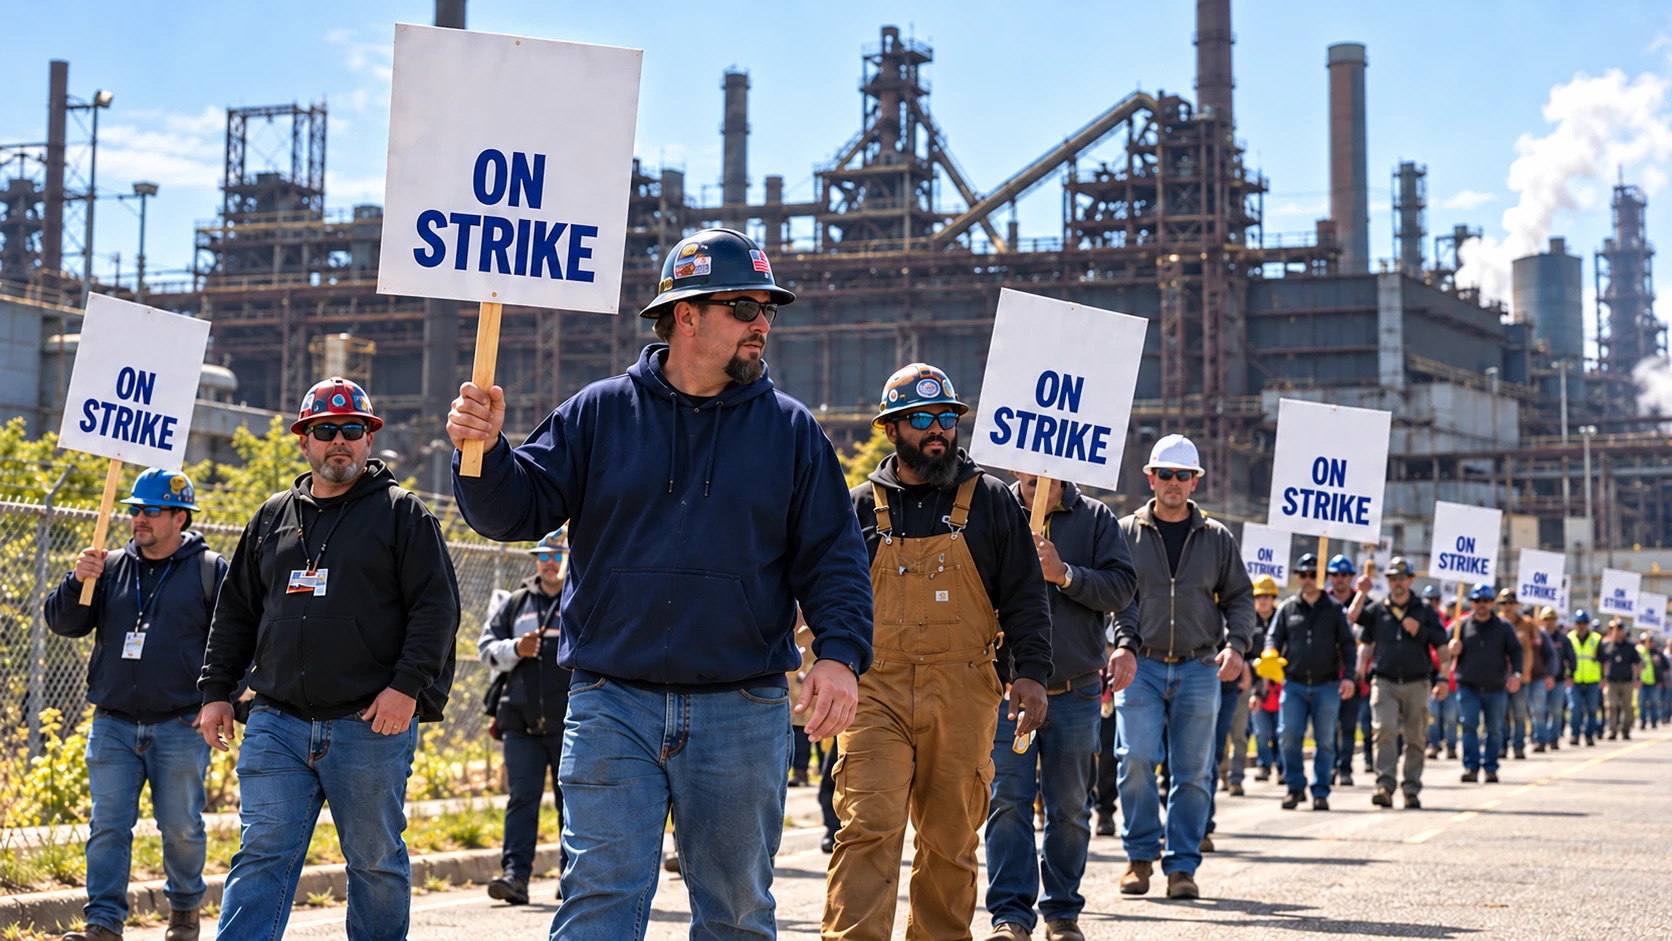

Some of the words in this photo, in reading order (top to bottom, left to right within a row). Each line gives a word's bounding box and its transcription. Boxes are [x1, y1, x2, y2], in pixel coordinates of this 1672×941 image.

[473, 149, 547, 210] ON
[412, 209, 599, 283] STRIKE
[116, 366, 157, 406] ON
[1036, 369, 1085, 413] ON
[80, 398, 178, 451] STRIKE
[989, 406, 1112, 464] STRIKE
[1311, 456, 1348, 489] ON
[1282, 486, 1372, 526] STRIKE
[1257, 547, 1273, 562] ON
[1456, 535, 1476, 554] ON
[1247, 562, 1284, 579] STRIKE
[1438, 552, 1490, 576] STRIKE
[1533, 572, 1548, 585] ON
[1521, 584, 1557, 601] STRIKE
